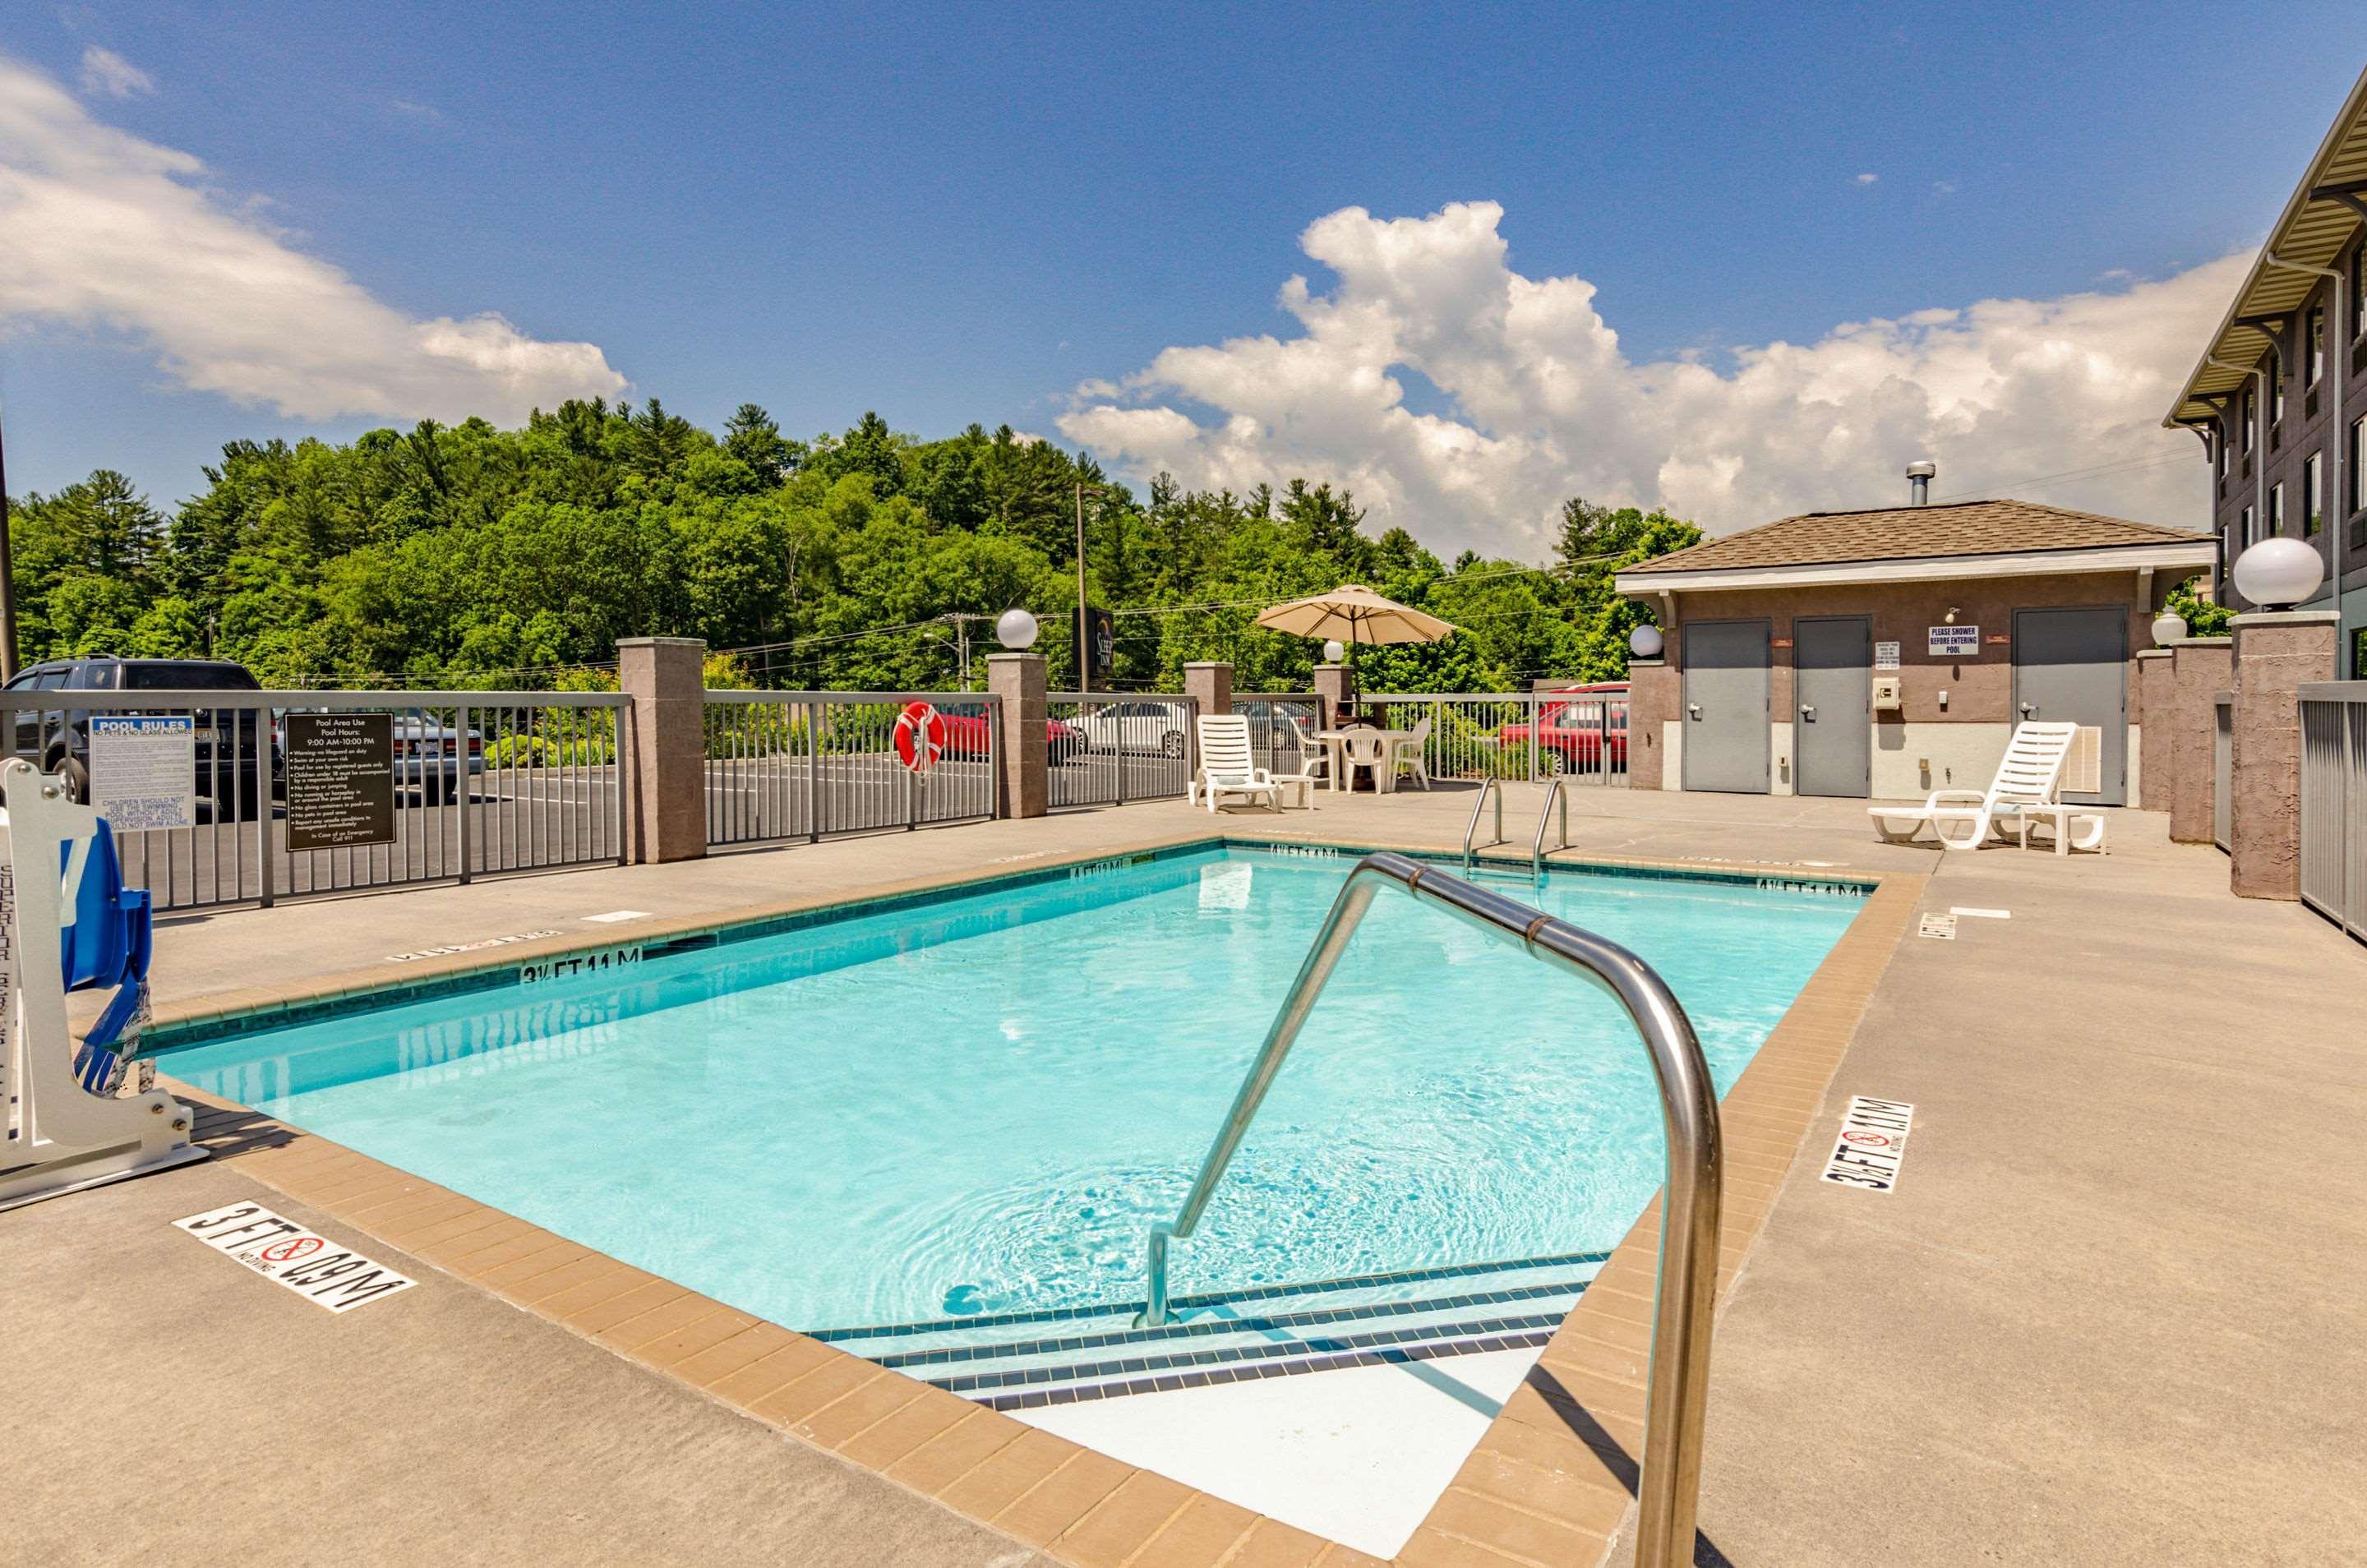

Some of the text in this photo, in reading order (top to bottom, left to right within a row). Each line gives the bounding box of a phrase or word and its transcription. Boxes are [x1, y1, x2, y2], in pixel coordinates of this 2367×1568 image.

[1097, 631, 1113, 656] SLEEP
[1101, 655, 1110, 666] INN
[100, 721, 186, 731] POOL RULES
[103, 797, 139, 806] CHILDREN
[1783, 881, 1806, 892] FT
[1839, 884, 1857, 896] M
[555, 958, 582, 978] FT
[618, 948, 639, 966] M
[1854, 1098, 1910, 1117] M
[1834, 1144, 1897, 1171] FT
[1826, 1164, 1893, 1188] 3½
[188, 1207, 406, 1308] 3 FT 0.9 M
